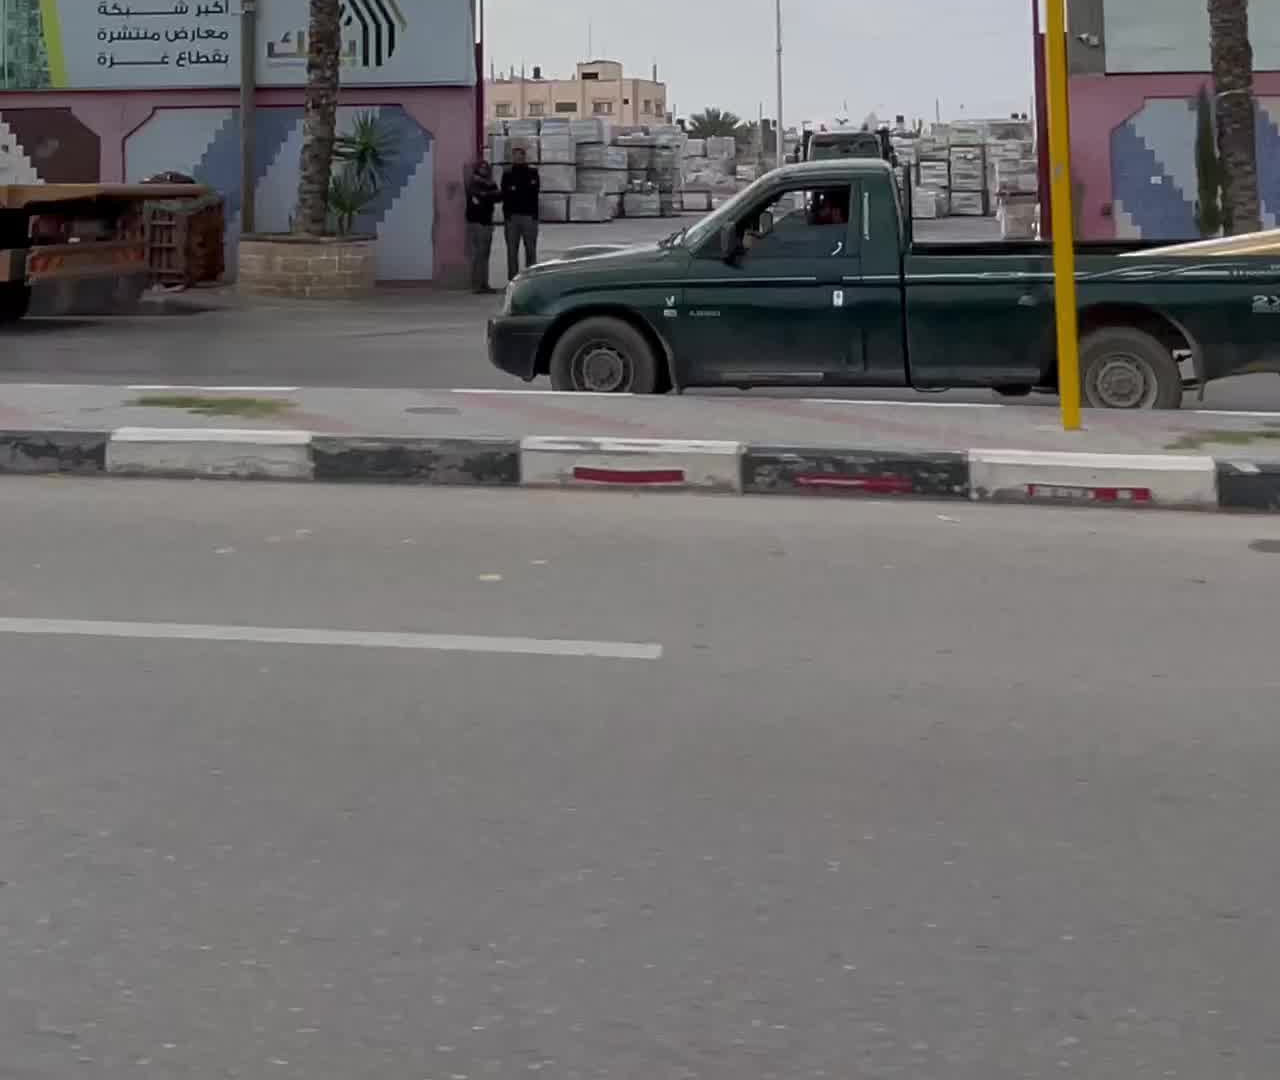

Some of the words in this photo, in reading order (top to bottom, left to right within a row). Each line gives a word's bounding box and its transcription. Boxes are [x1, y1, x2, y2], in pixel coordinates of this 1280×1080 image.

[97, 0, 189, 16] شبكة
[97, 25, 161, 41] منتشرة
[164, 25, 229, 41] معارض
[97, 50, 169, 66] غزة
[175, 49, 229, 67] بقطاع
